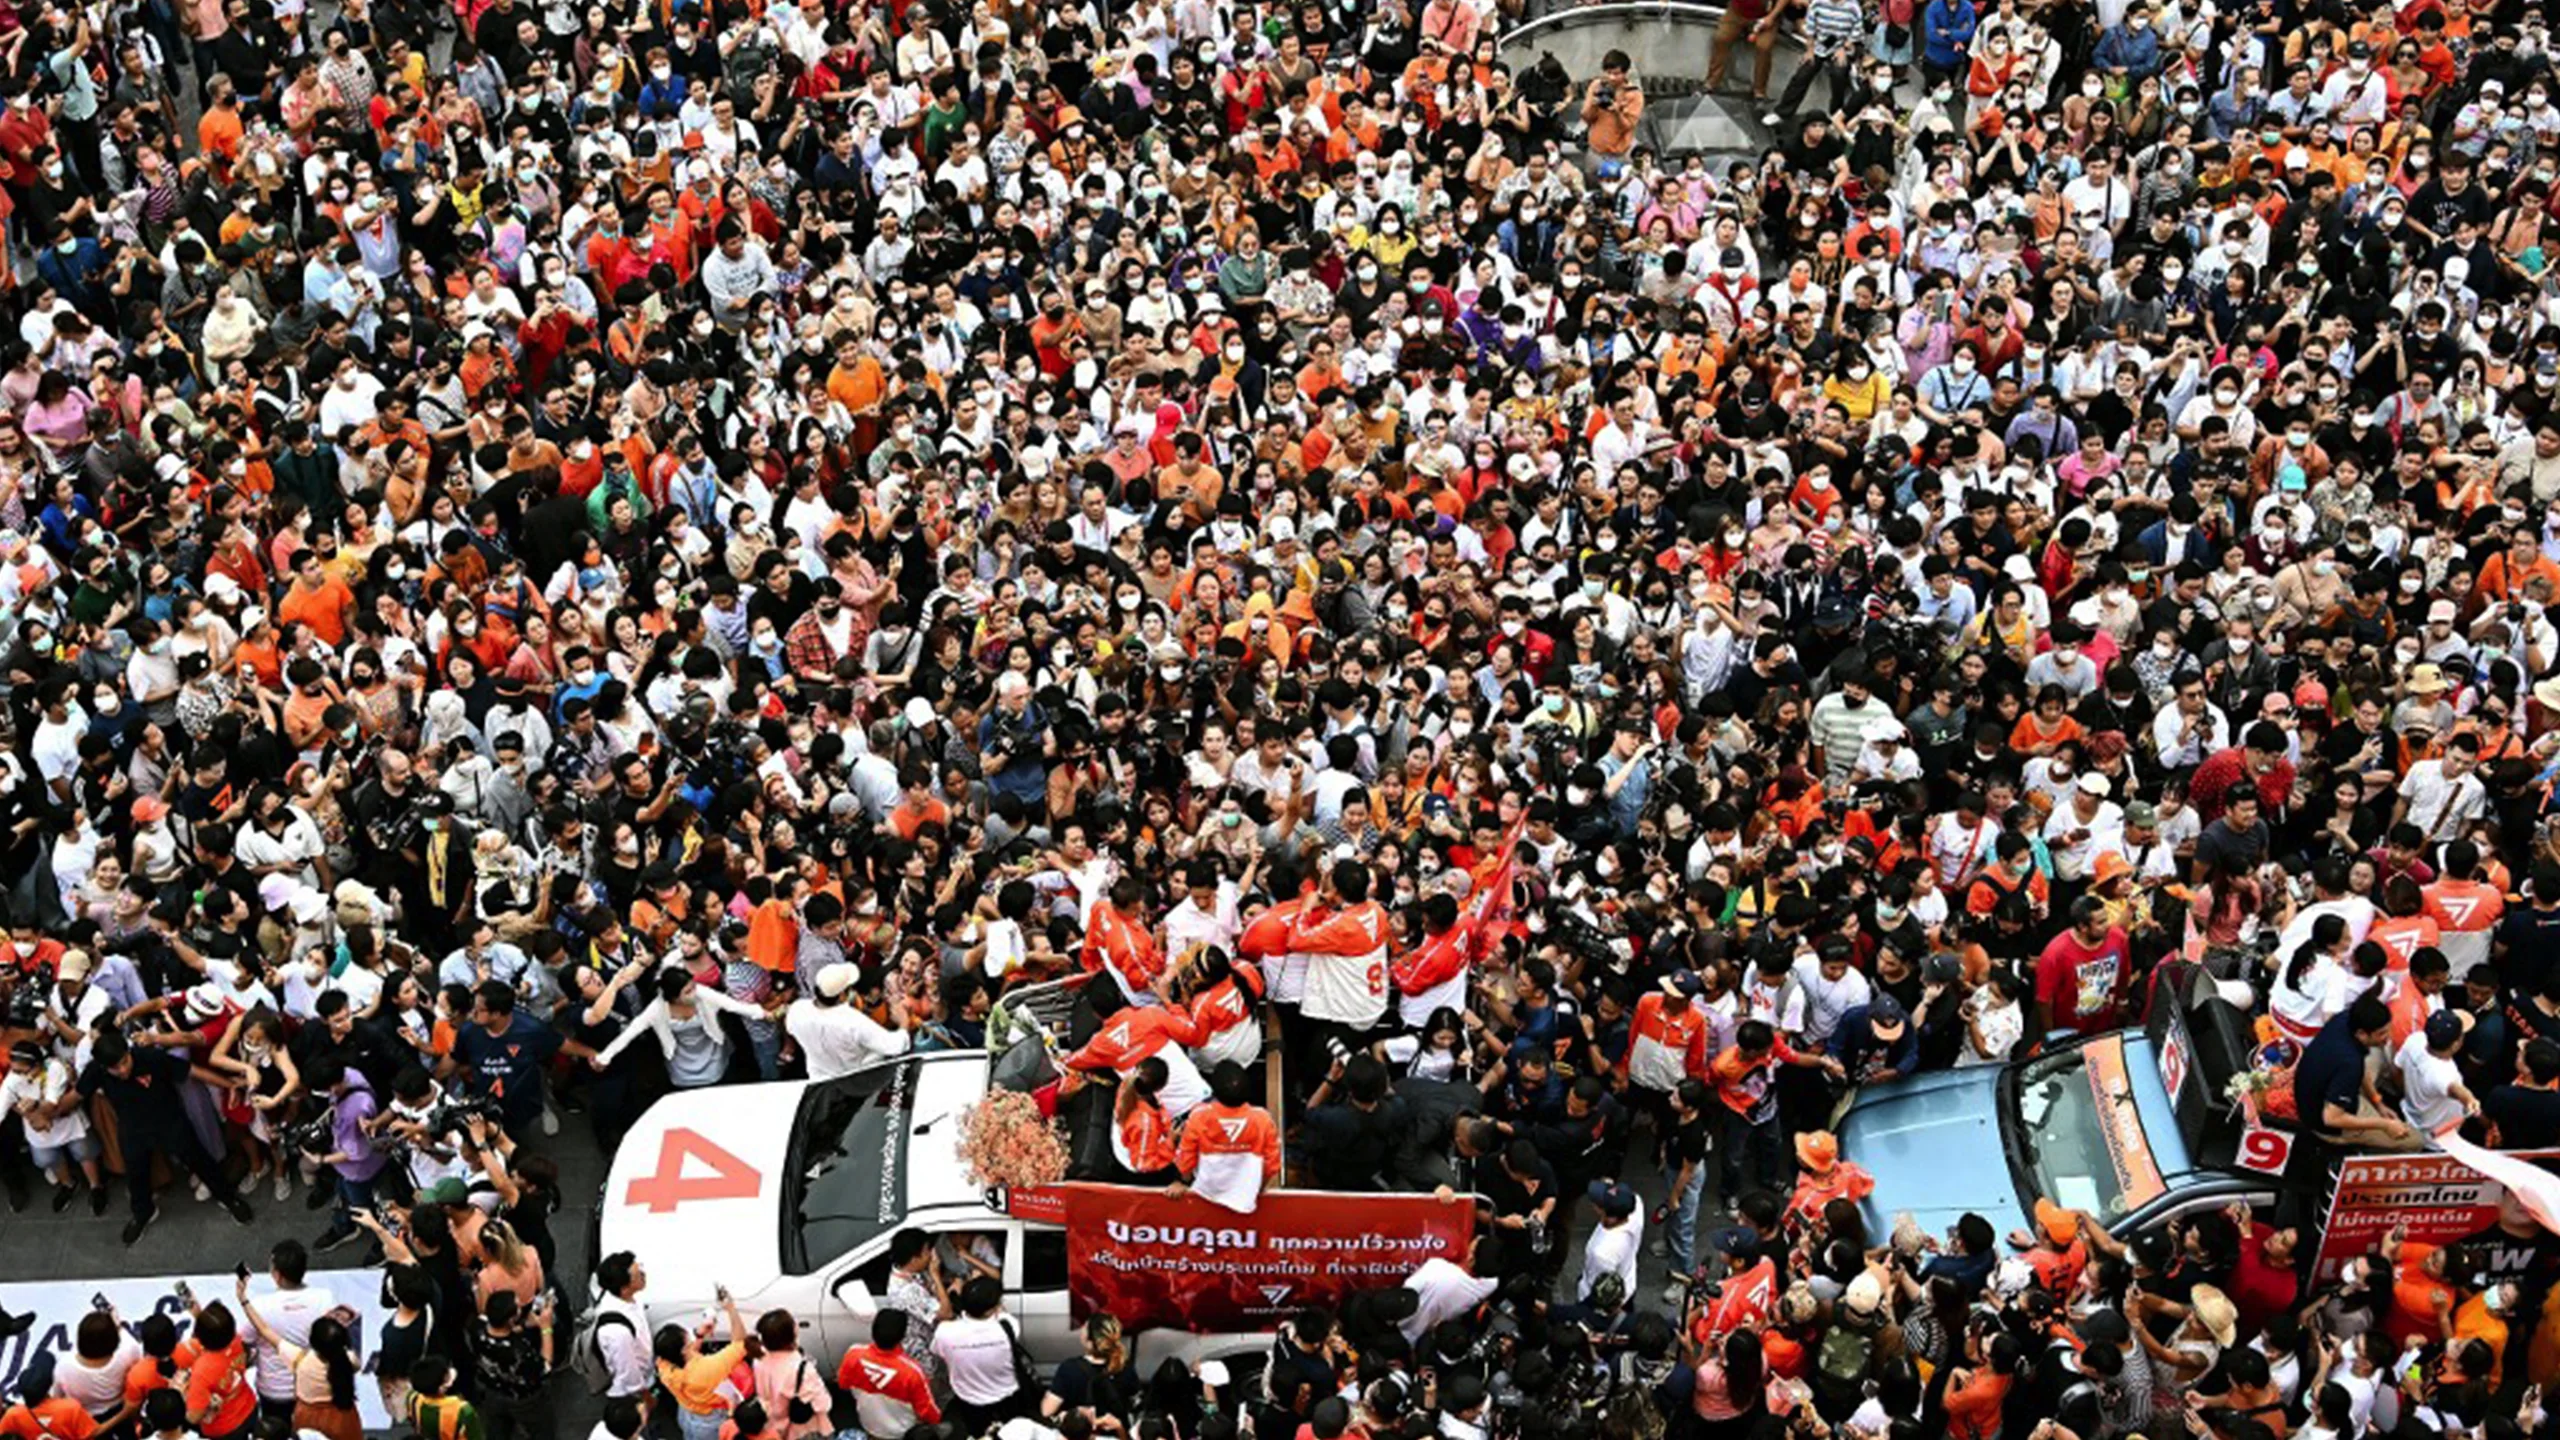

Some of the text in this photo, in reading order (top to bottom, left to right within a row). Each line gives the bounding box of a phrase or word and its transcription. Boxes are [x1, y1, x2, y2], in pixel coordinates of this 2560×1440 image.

[2245, 1131, 2288, 1170] 9
[624, 1126, 762, 1213] 4
[2341, 1186, 2479, 1206] ประเทศไทย
[2334, 1209, 2473, 1228] ไม่เหมือนเดิม
[1106, 1219, 1446, 1254] ขอบคุณ ทุกความไว้วางใจ
